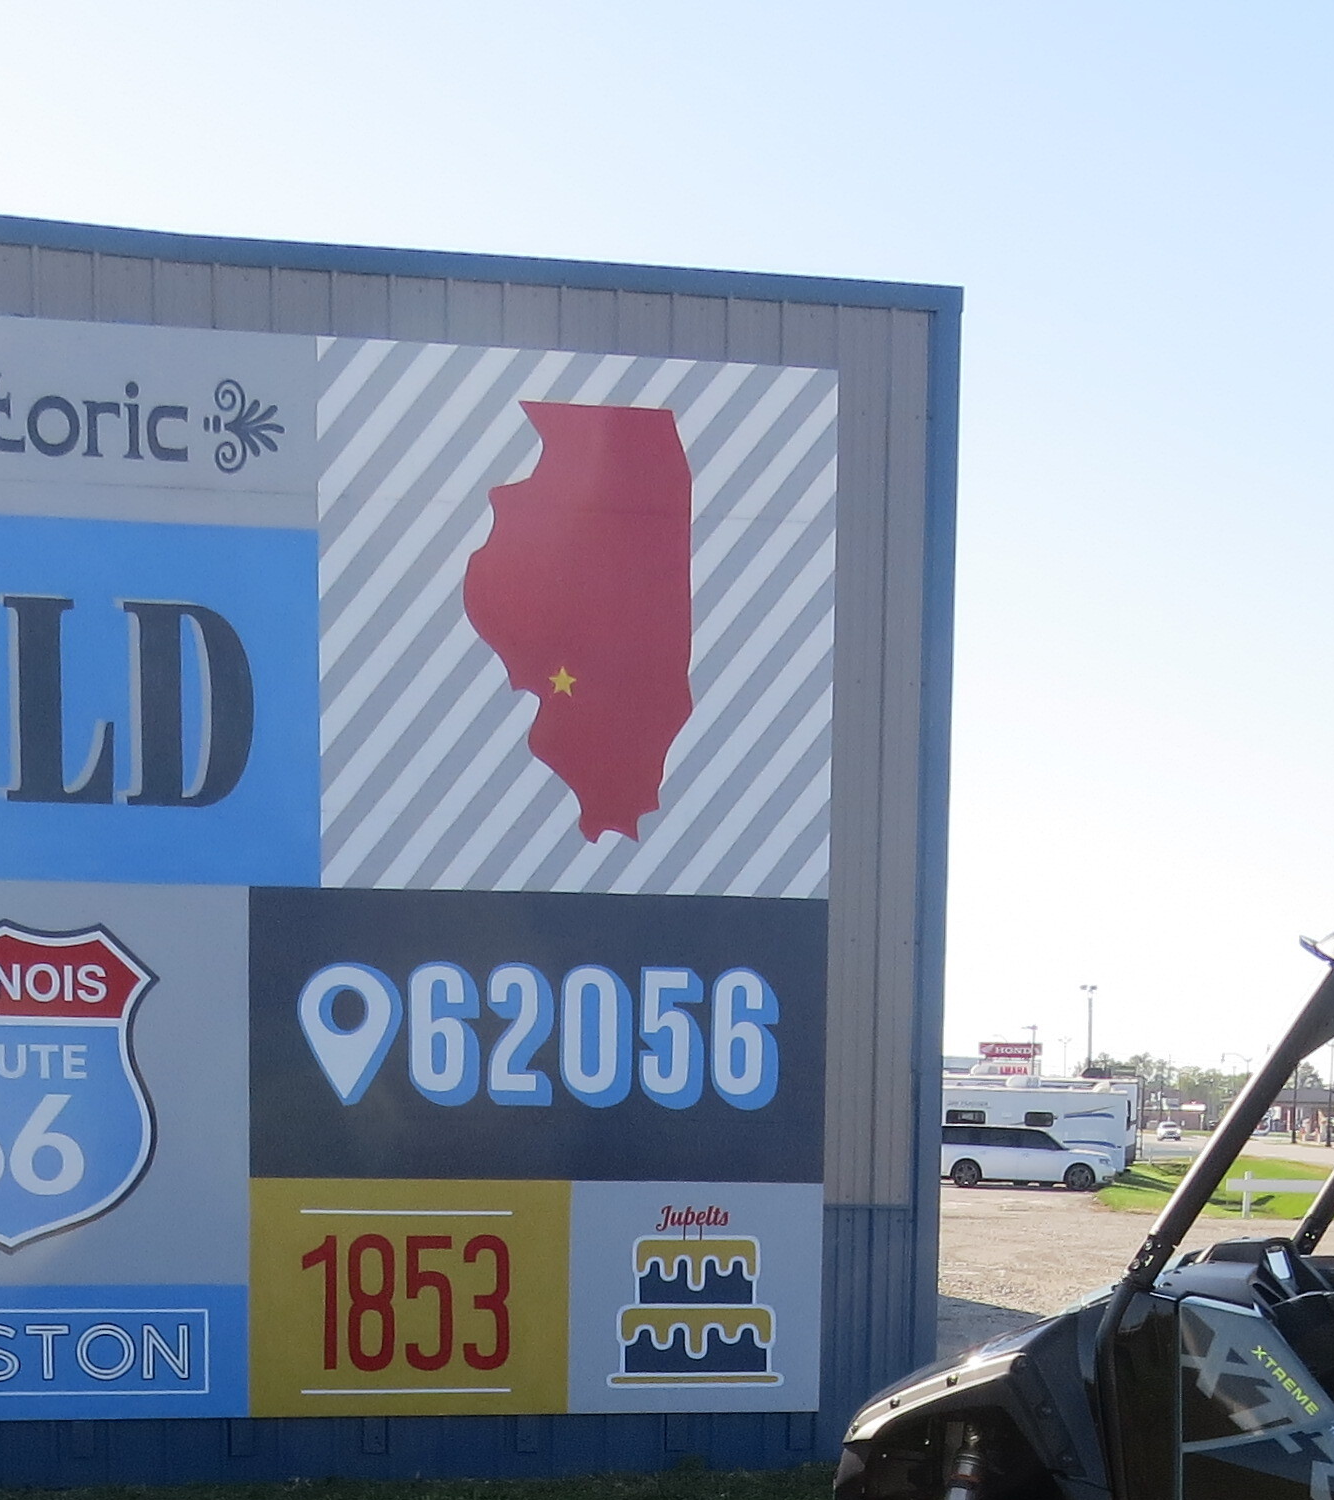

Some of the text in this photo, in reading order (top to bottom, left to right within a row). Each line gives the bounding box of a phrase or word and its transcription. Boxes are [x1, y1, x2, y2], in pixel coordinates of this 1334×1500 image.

[407, 960, 781, 1111] 62056
[655, 1205, 729, 1232] Jubelts
[301, 1234, 512, 1373] 1853
[1251, 1345, 1320, 1416] XTREME
